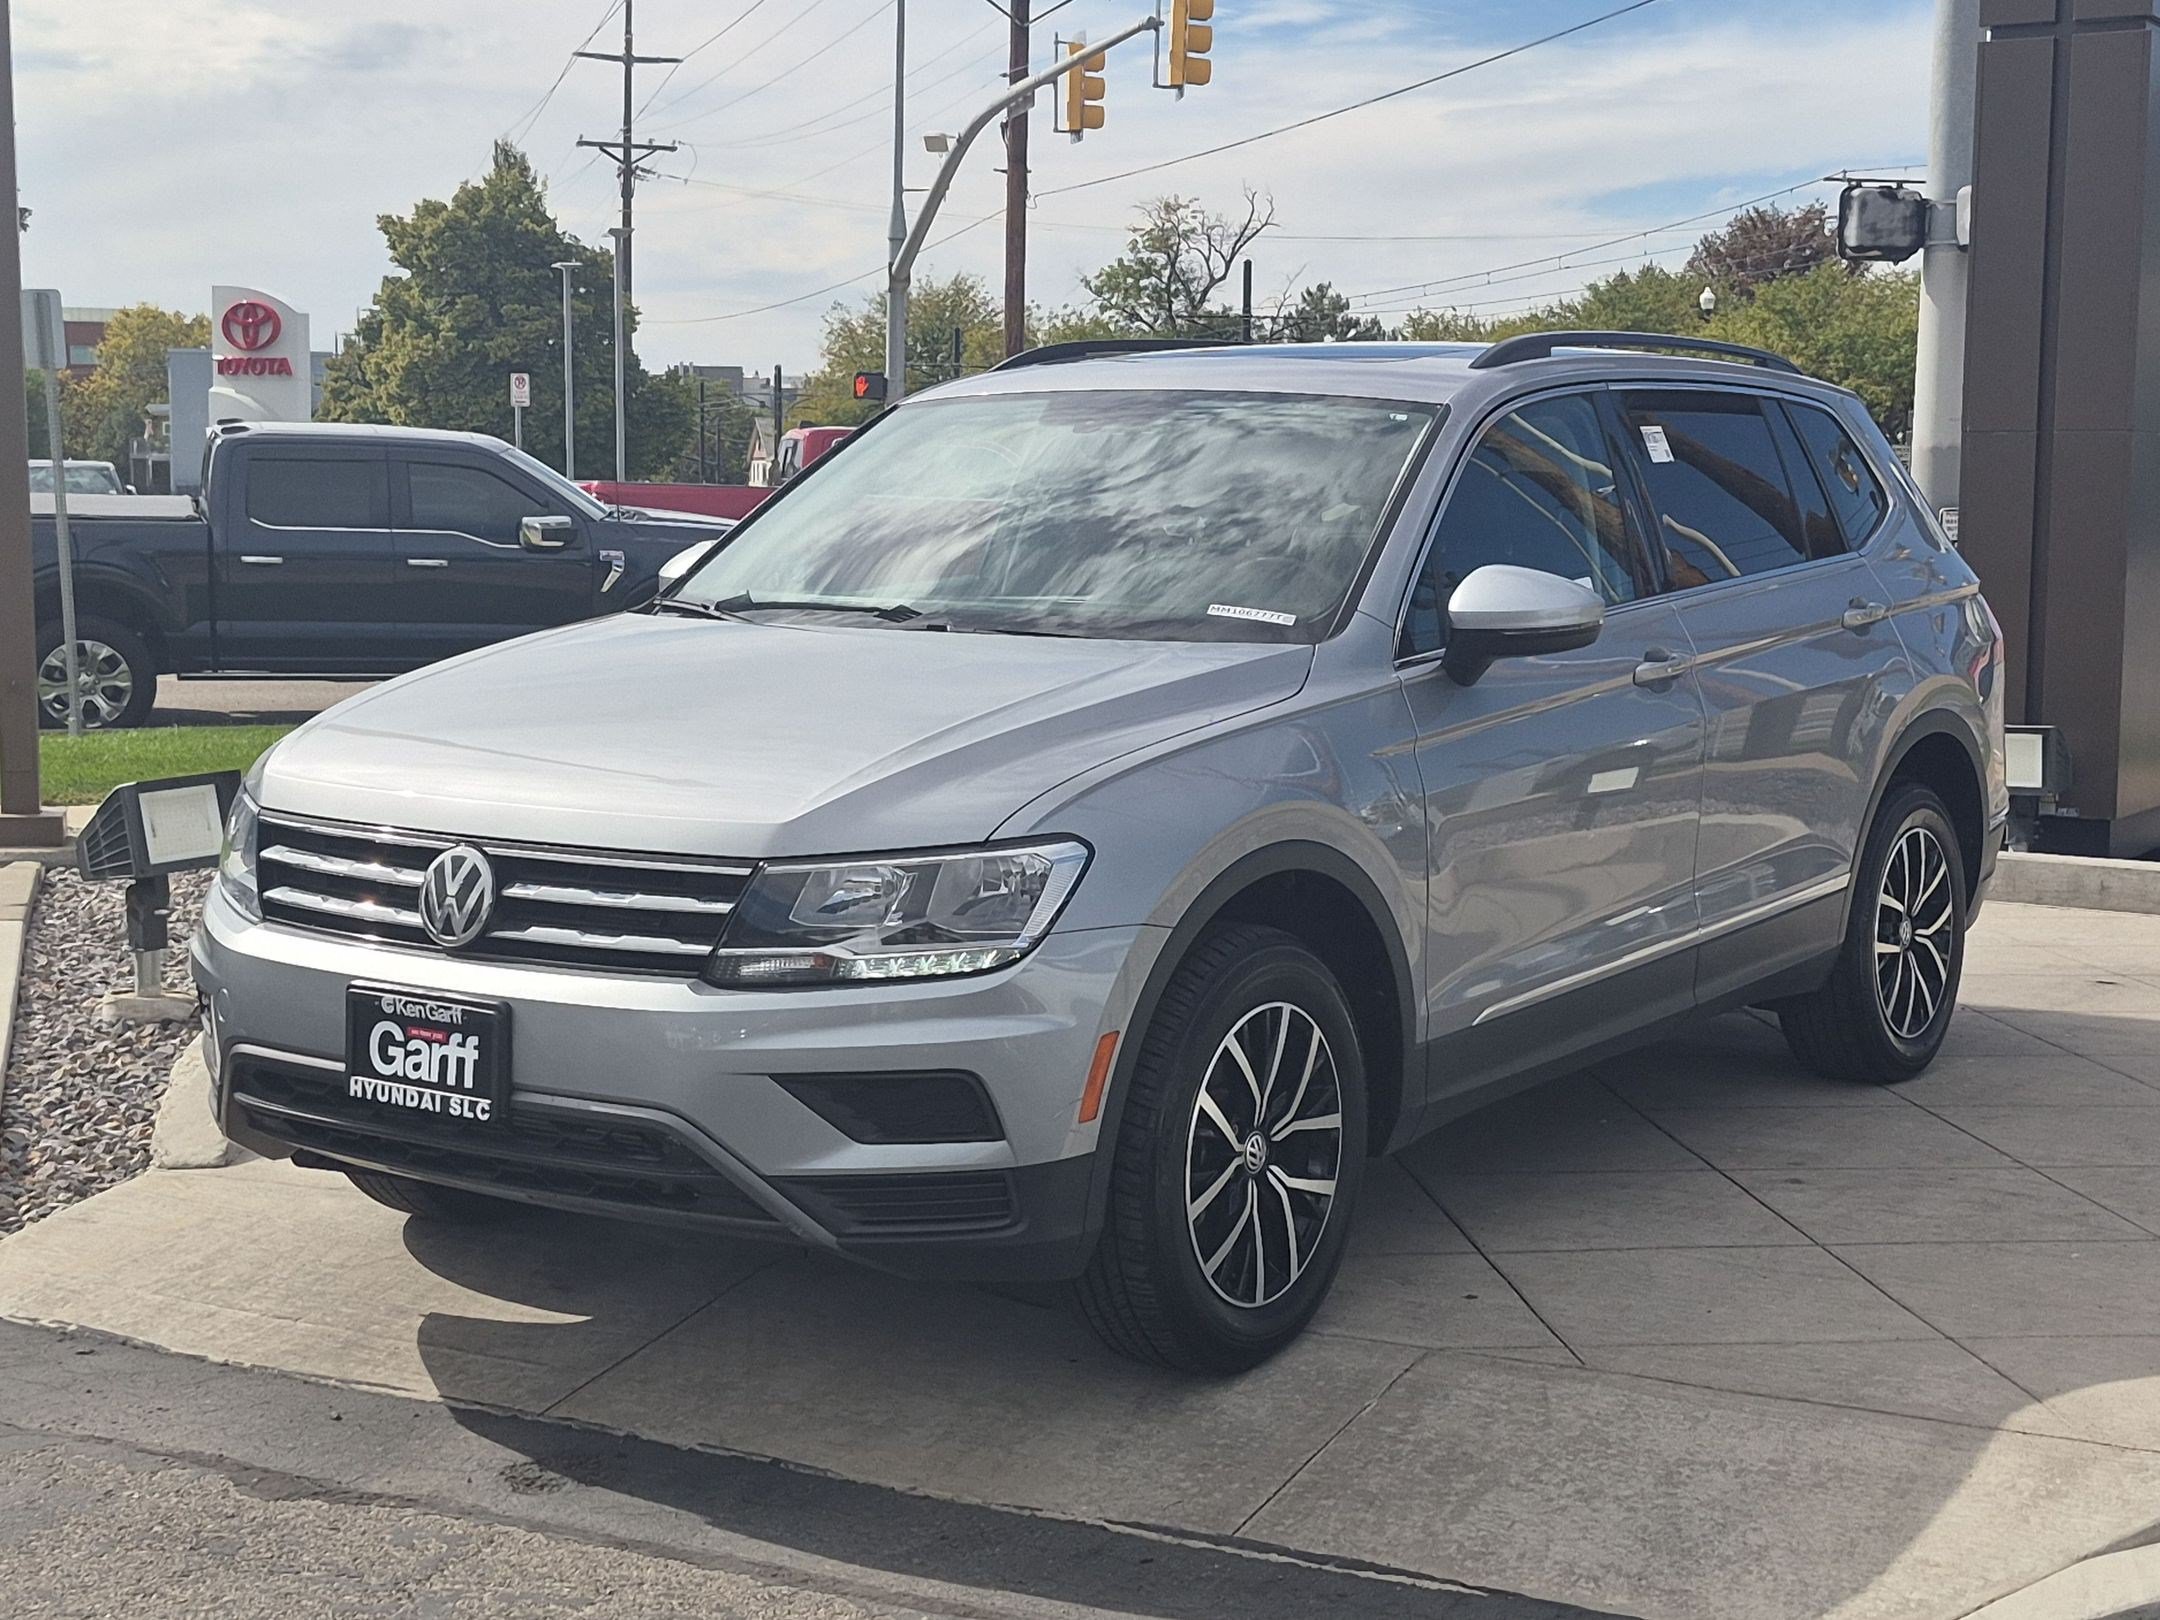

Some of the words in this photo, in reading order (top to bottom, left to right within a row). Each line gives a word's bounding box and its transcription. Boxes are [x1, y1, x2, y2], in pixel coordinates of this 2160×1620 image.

[215, 356, 292, 376] TOYOTA
[370, 1020, 479, 1089] Garff
[350, 1078, 441, 1112] HYUNDAI
[449, 1096, 491, 1121] SLC
